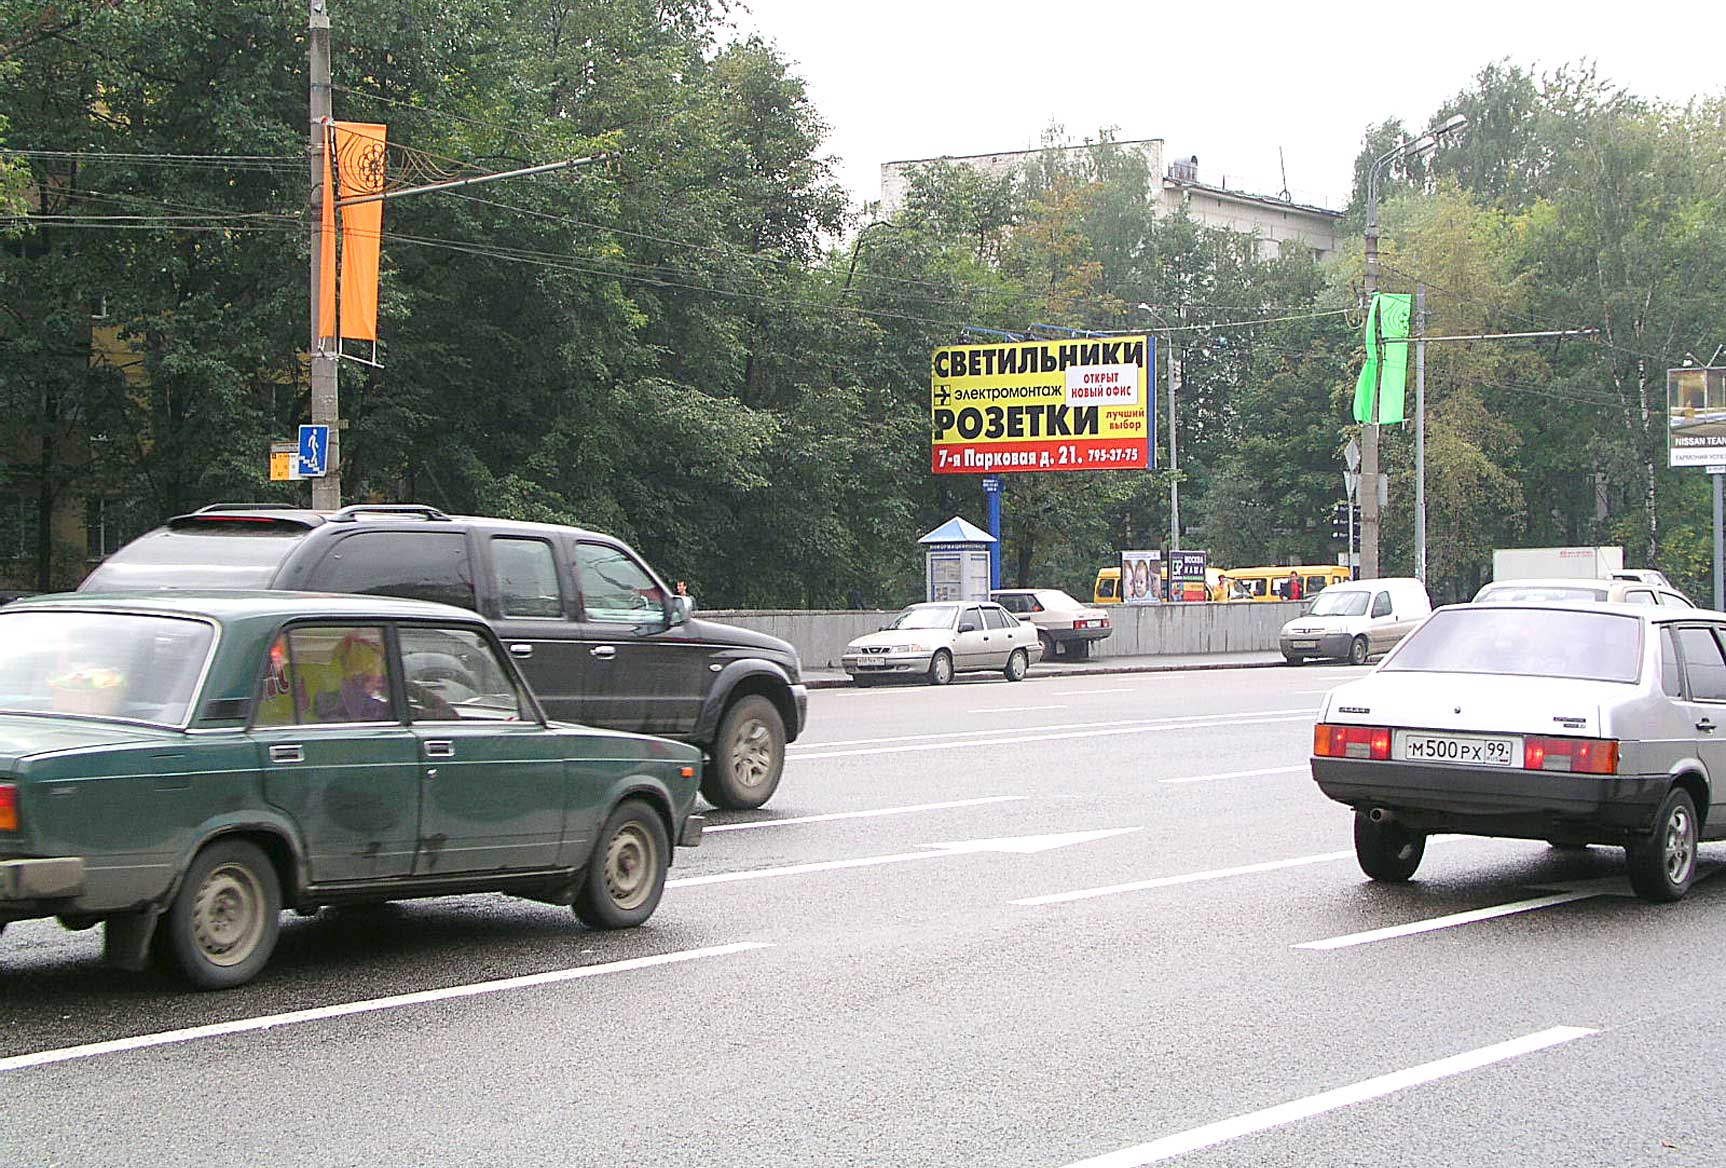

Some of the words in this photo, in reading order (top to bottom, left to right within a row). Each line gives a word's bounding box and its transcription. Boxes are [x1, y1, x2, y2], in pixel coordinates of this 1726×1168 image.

[934, 341, 1144, 378] СВЕТИЛЬНИКИ
[1083, 372, 1119, 384] ОТКРЫТ
[954, 385, 1062, 402] электромонтаж
[1071, 385, 1104, 399] НОВЫЙ
[1106, 385, 1132, 397] ОФИС
[1105, 409, 1145, 420] лучший
[934, 405, 1099, 440] РОЗЕТКИ
[1109, 420, 1142, 431] выбор
[1675, 437, 1706, 446] NISSAN
[938, 449, 961, 468] 7-я
[964, 449, 1036, 470] Парковая
[1039, 451, 1055, 468] д.
[1058, 446, 1083, 464] 21.
[1087, 447, 1138, 463] 795-37-75
